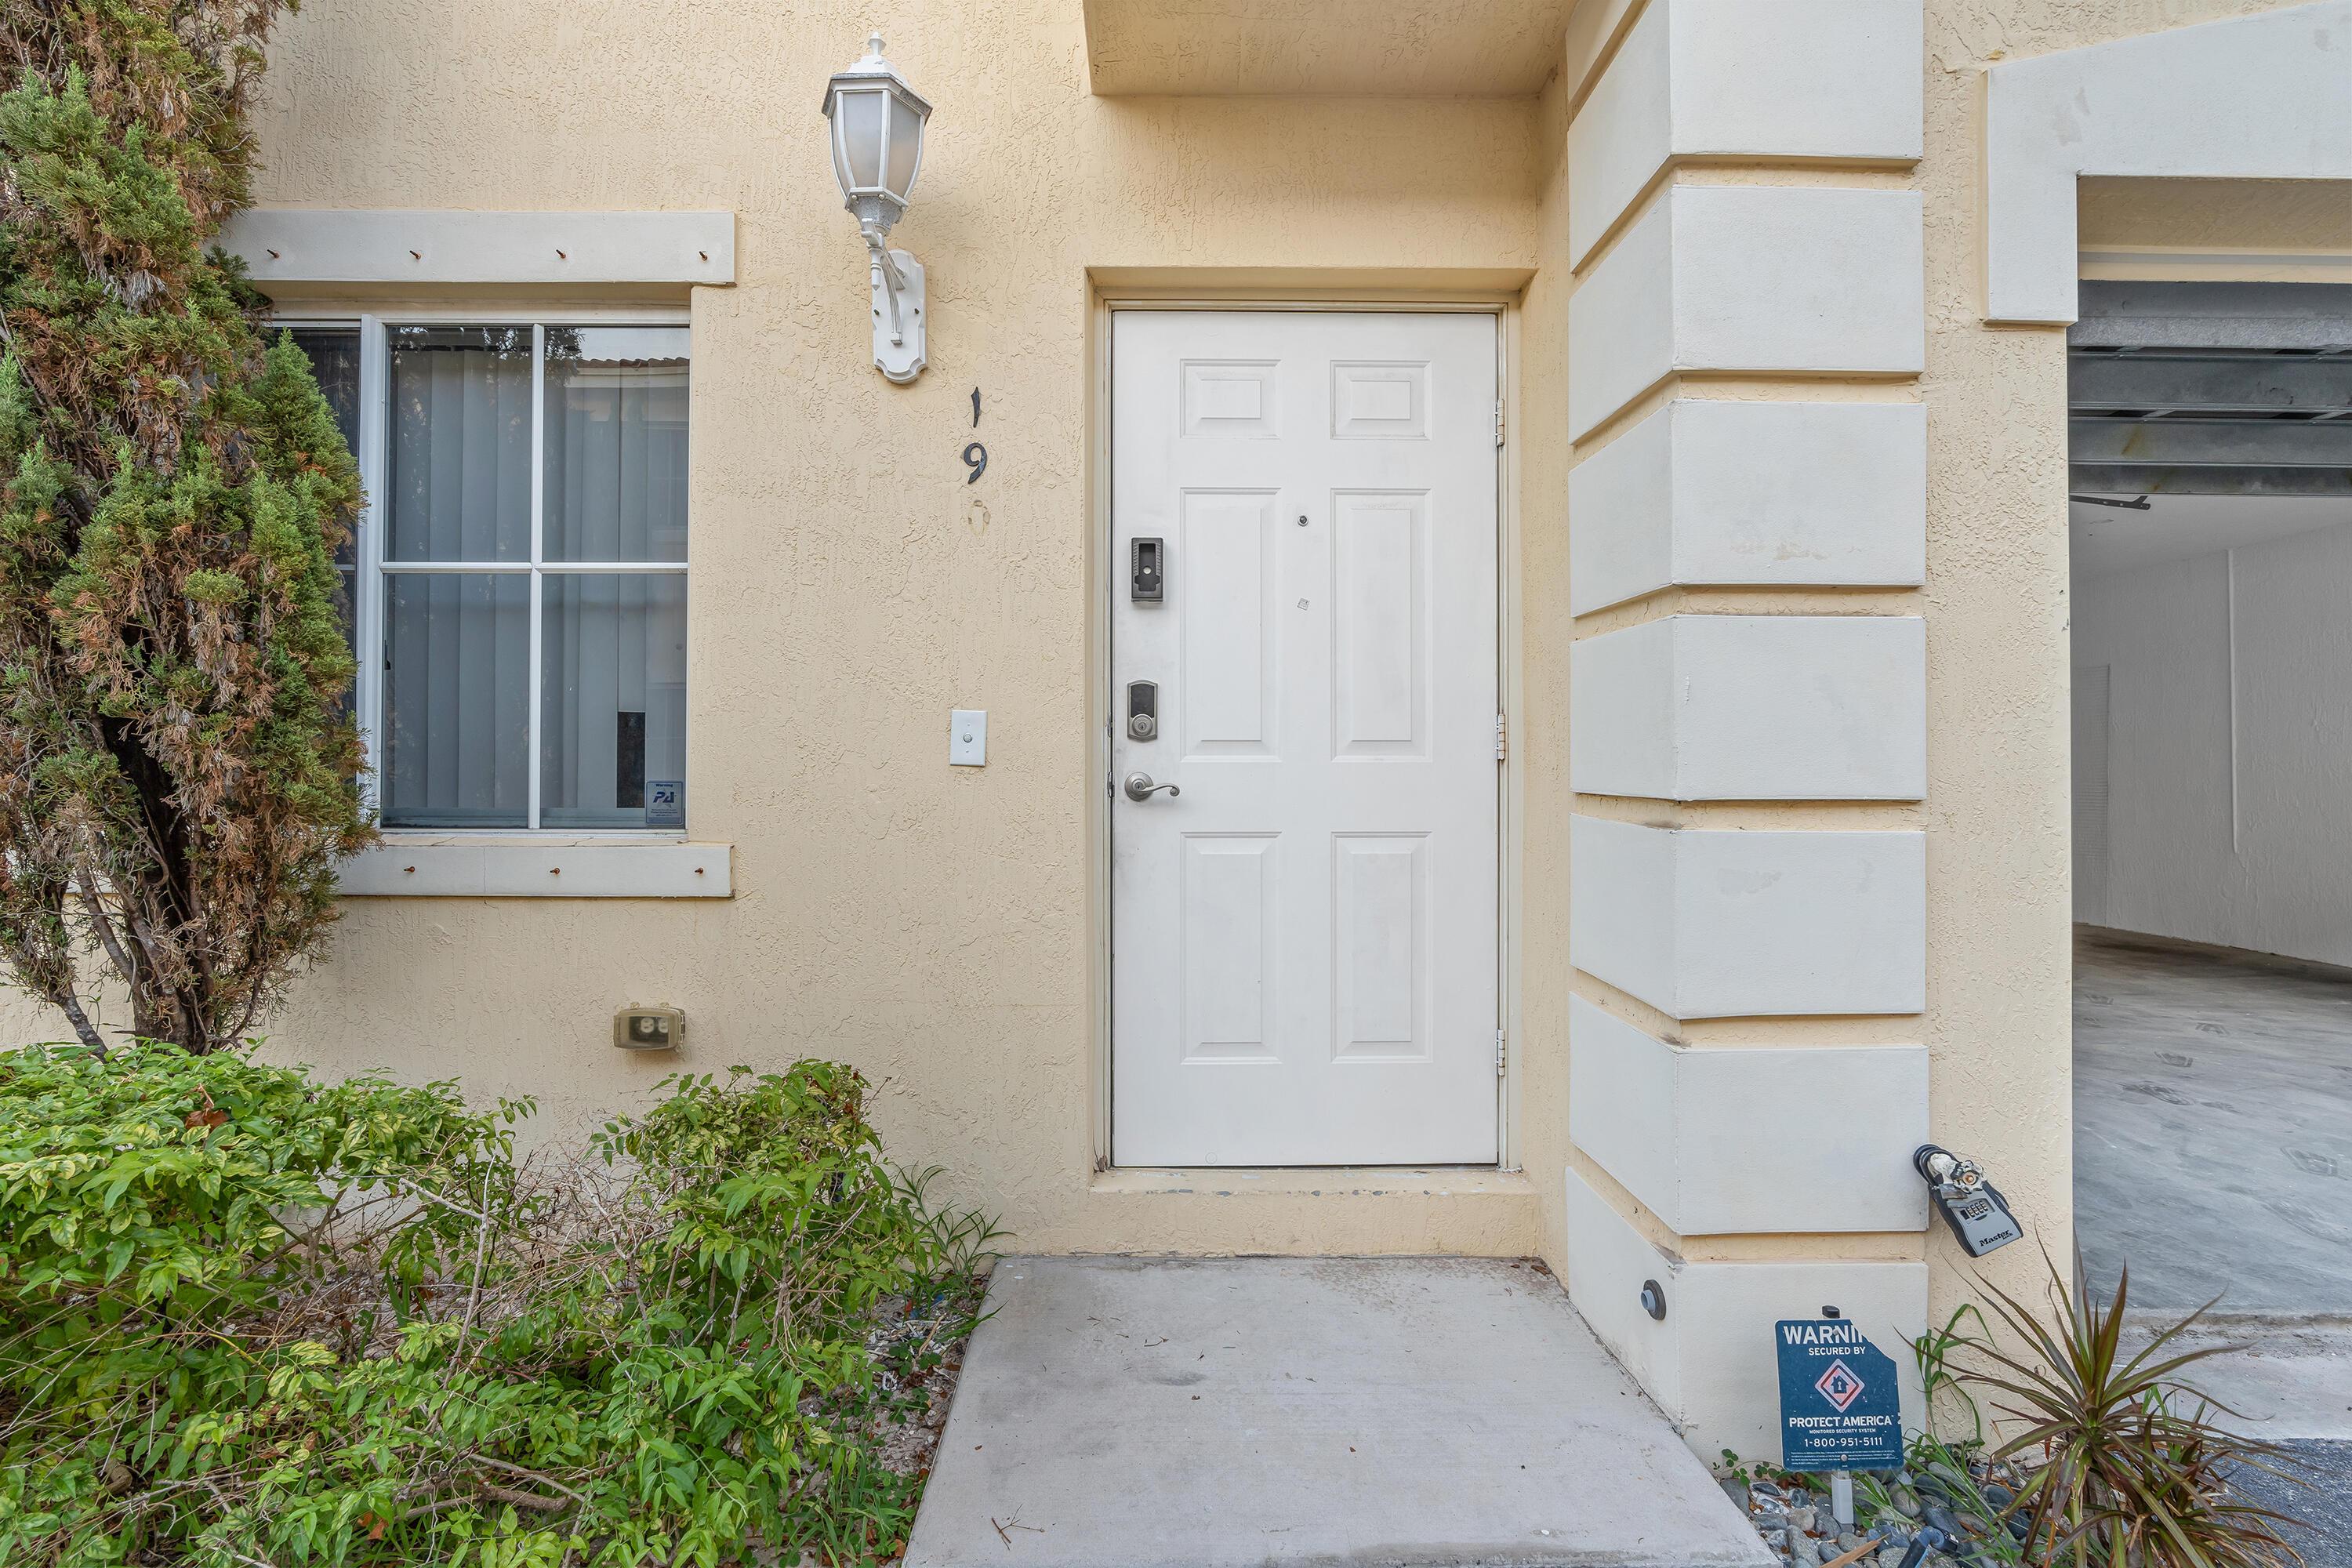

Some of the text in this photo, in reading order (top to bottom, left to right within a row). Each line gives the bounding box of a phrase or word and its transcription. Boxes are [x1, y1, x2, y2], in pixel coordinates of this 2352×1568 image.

[1979, 1230, 2009, 1247] Master
[1809, 1346, 1866, 1356] SECURED BY
[1789, 1417, 1841, 1428] PROTECT
[1843, 1415, 1892, 1426] AMERICA
[1805, 1437, 1882, 1447] 1-800-951-5111
